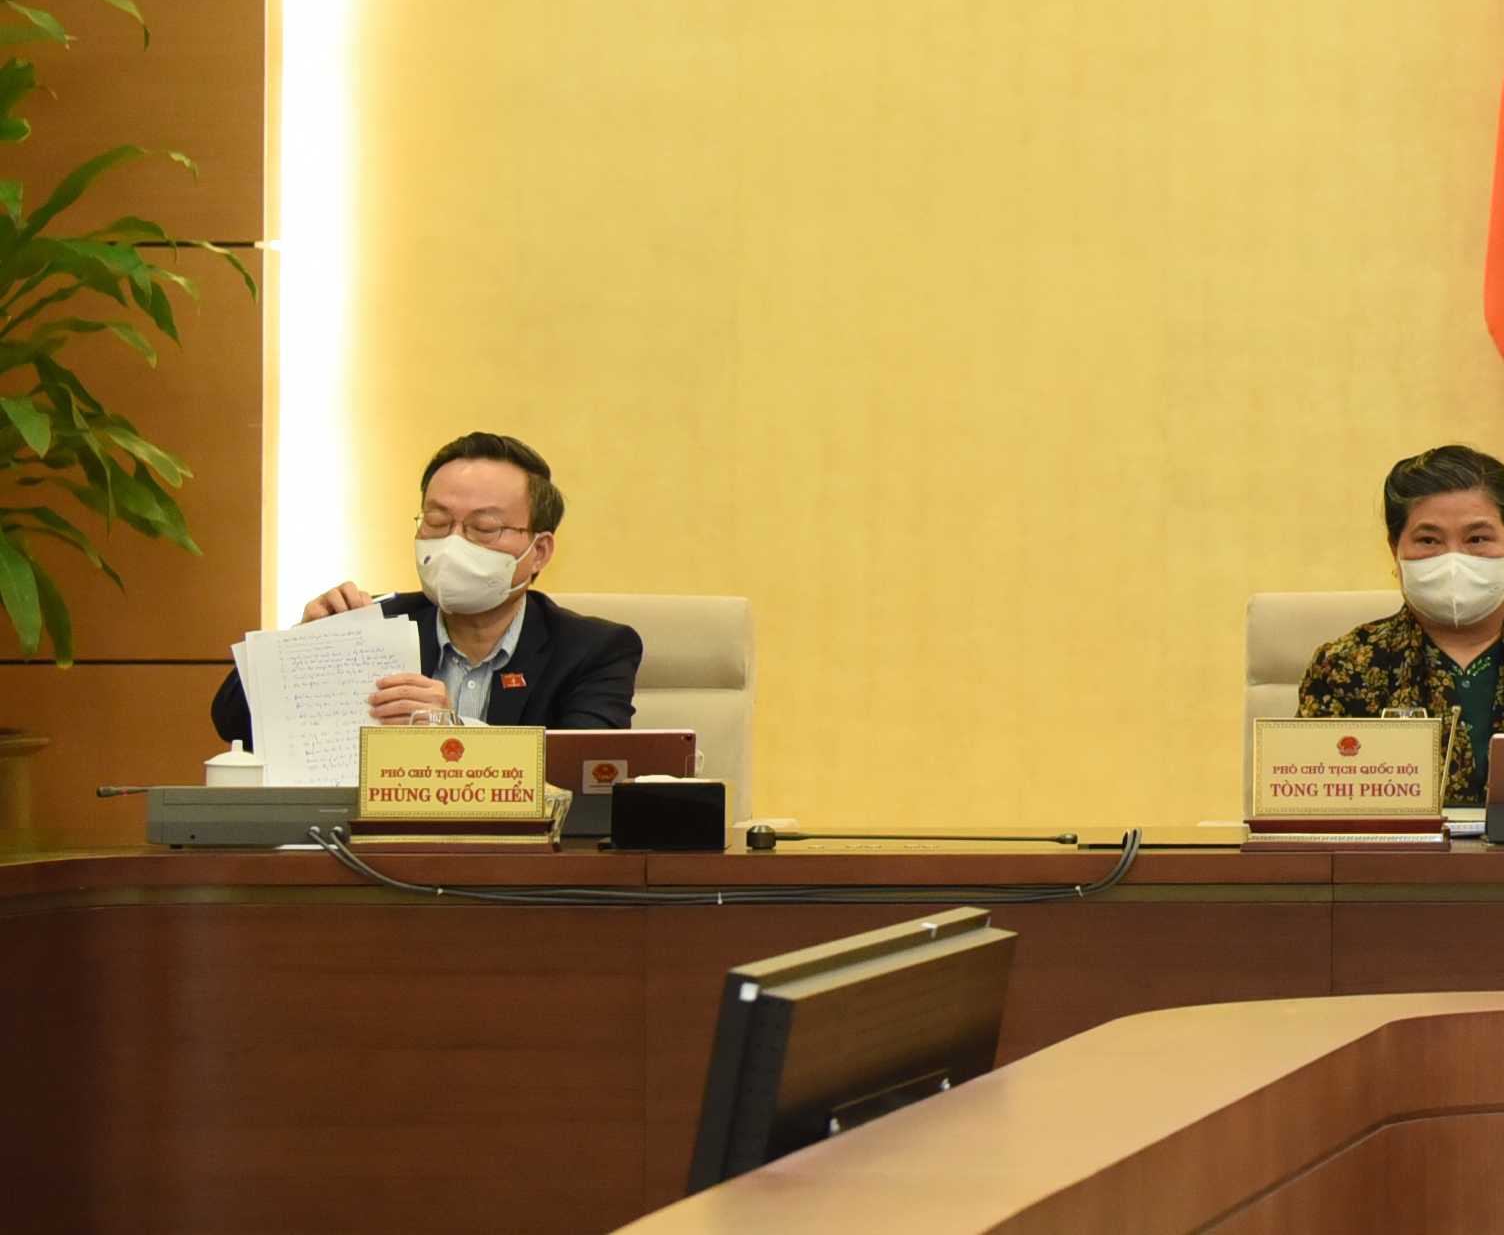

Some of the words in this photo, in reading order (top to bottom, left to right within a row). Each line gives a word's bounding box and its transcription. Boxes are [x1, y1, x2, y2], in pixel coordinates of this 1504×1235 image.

[380, 767, 405, 778] PHÓ
[408, 766, 432, 778] CHỦ
[435, 769, 463, 780] TỊCH
[466, 766, 499, 779] QUỐC
[502, 767, 524, 780] HỘI
[1273, 764, 1298, 775] PHÓ
[1300, 762, 1325, 775] CHỦ
[1328, 765, 1357, 777] TỊCH
[1359, 762, 1394, 775] QUỐC
[1396, 763, 1419, 777] HỘI
[369, 783, 432, 802] PHÙNG
[435, 782, 486, 805] QUỐC
[490, 780, 535, 803] HIỂN
[1270, 779, 1319, 797] TÒNG
[1323, 783, 1355, 801] THỊ
[1358, 779, 1422, 798] PHÓNG
